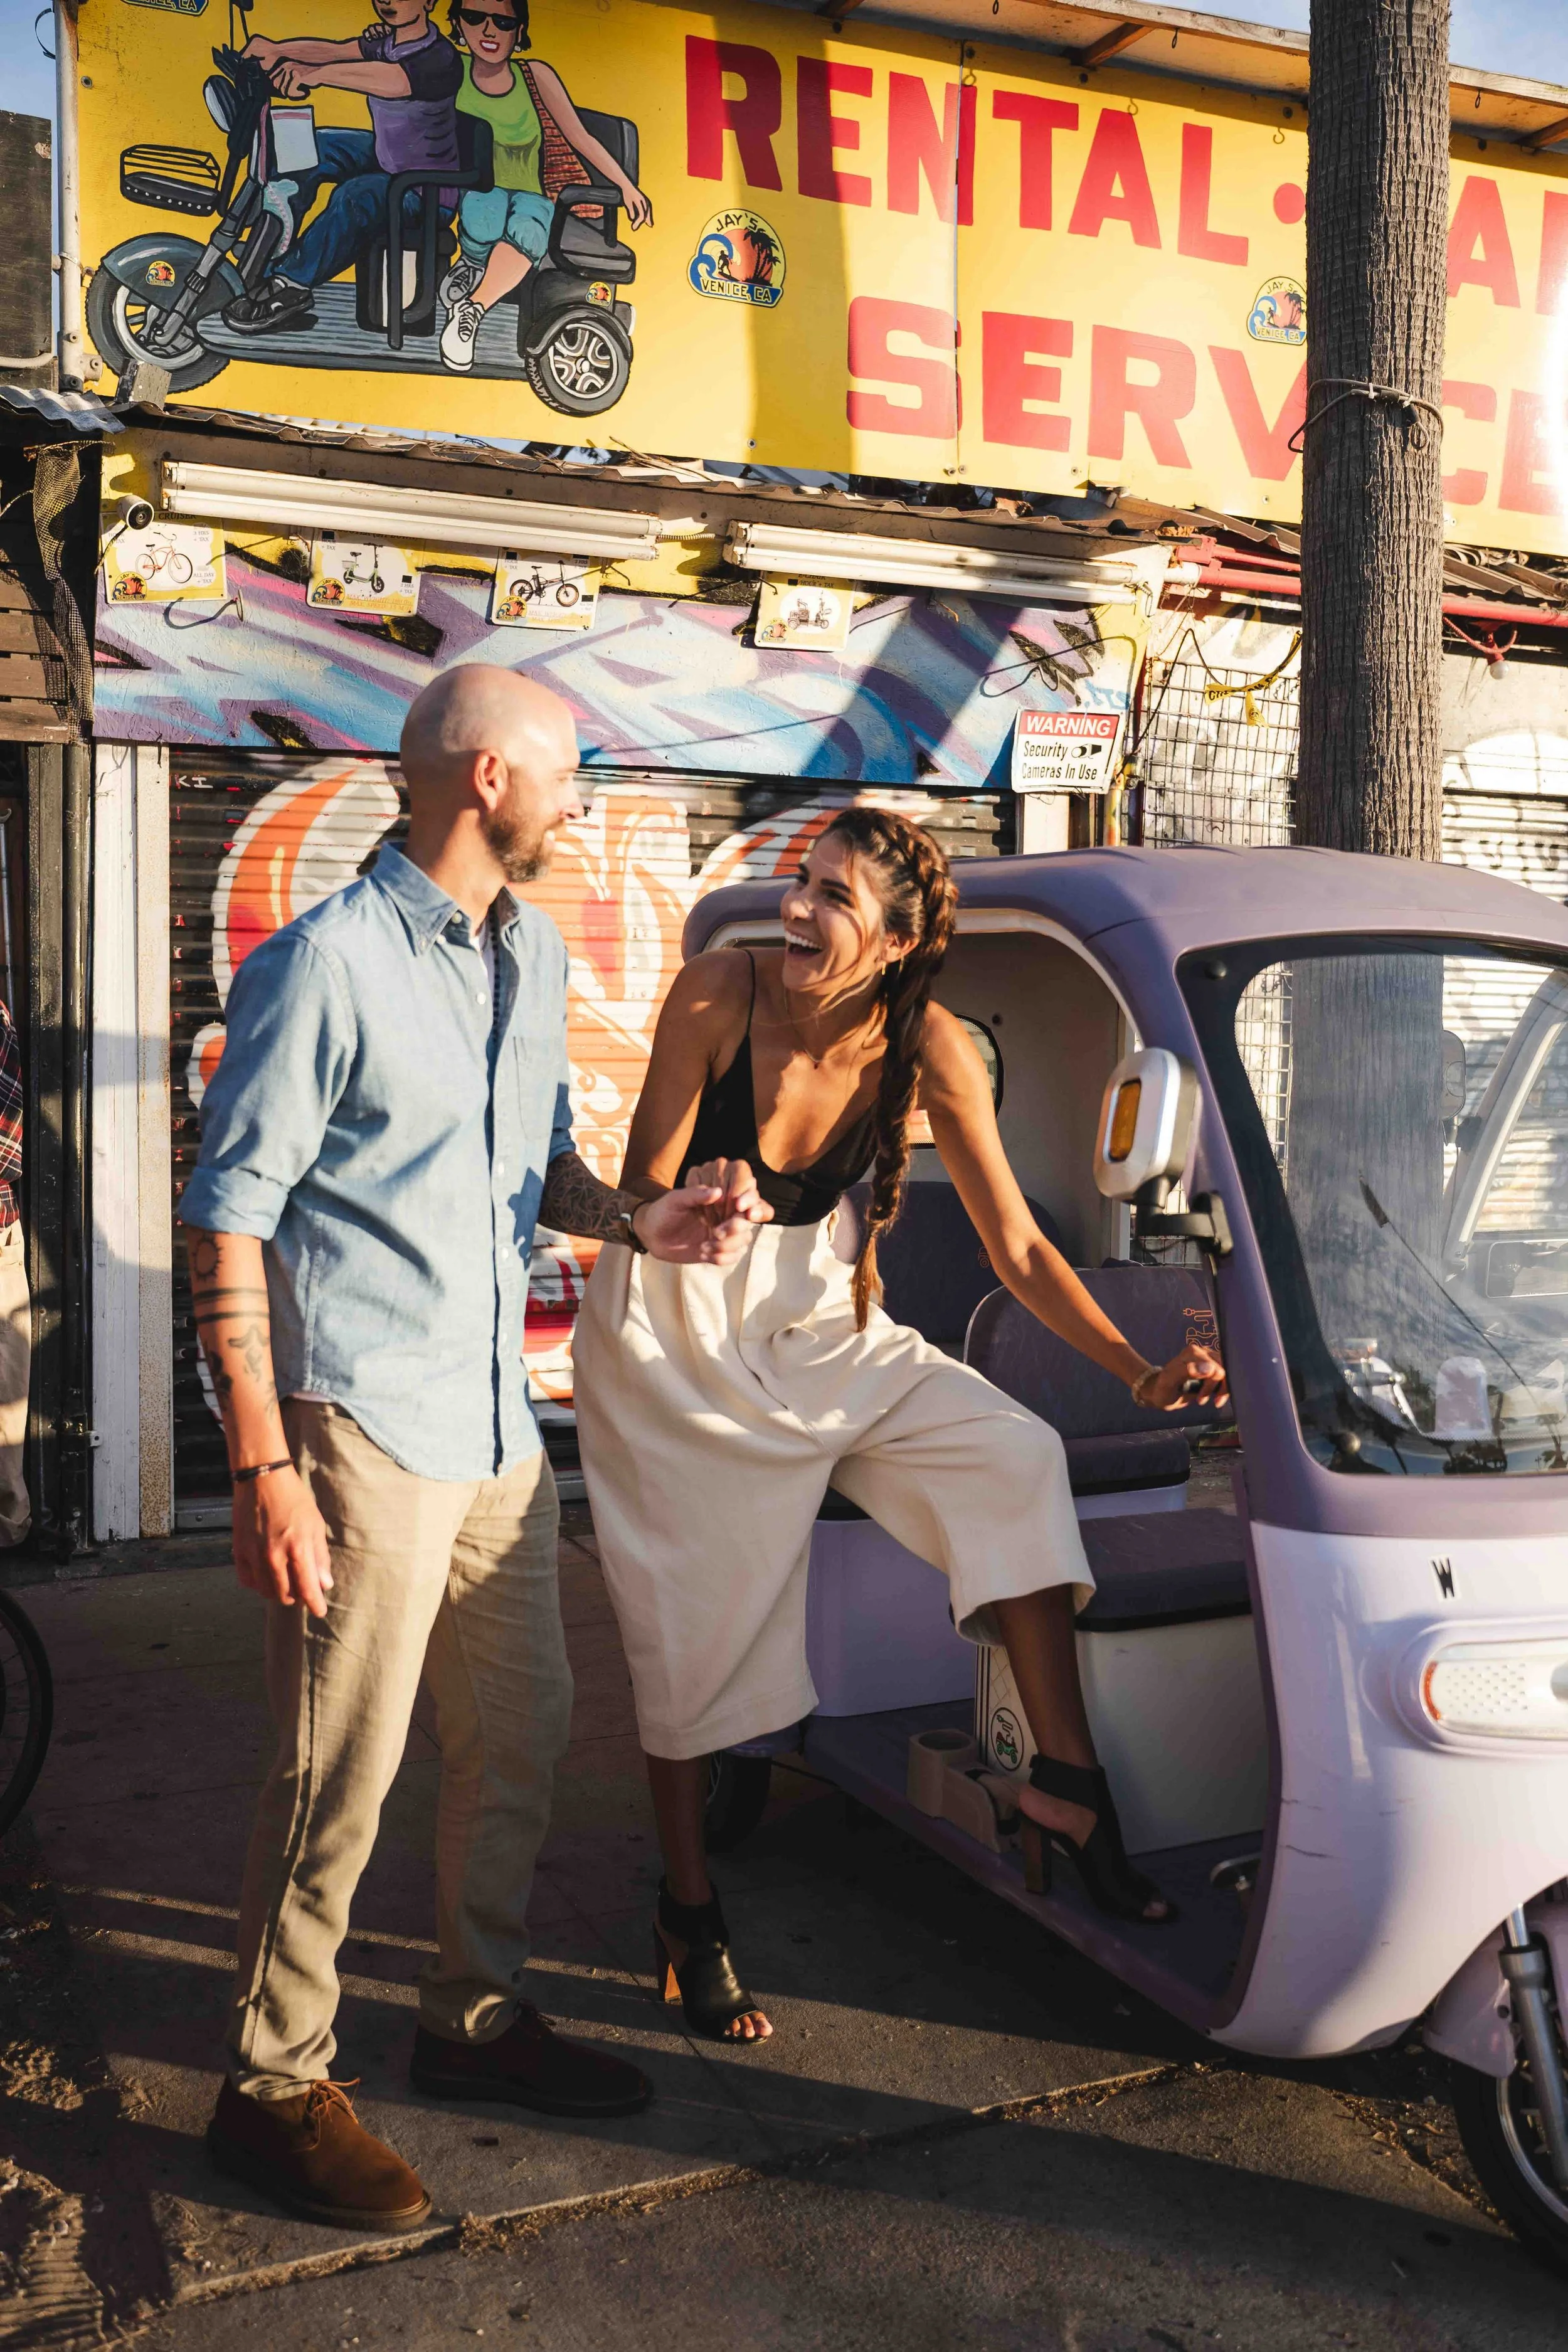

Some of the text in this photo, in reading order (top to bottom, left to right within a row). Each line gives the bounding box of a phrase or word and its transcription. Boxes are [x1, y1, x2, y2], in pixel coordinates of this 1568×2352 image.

[685, 35, 1249, 266] RENTAL
[716, 213, 758, 232] JAY'S
[701, 279, 771, 302] VENICE, CA
[847, 296, 1564, 516] SERVCE
[1027, 715, 1111, 736] WARNING
[1024, 741, 1068, 761] Security
[1022, 763, 1097, 780] Cameras In Use
